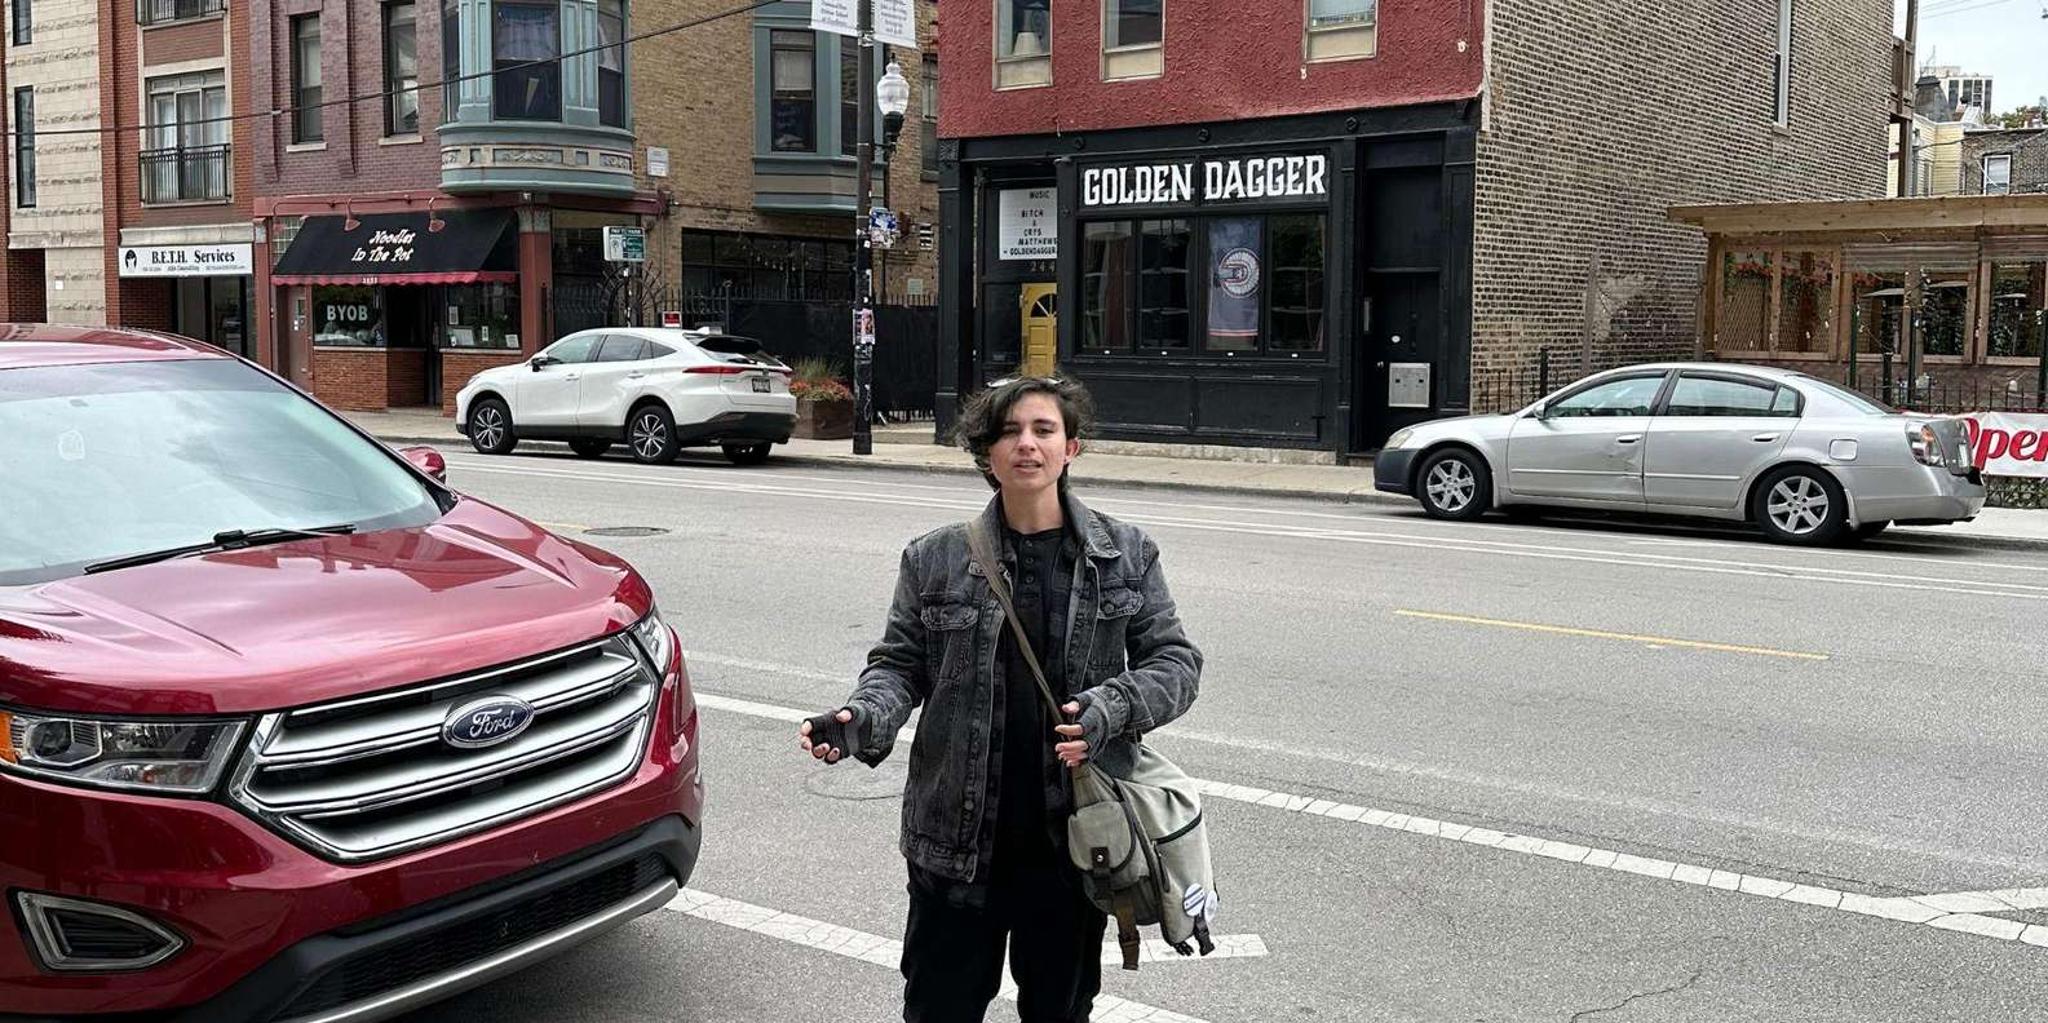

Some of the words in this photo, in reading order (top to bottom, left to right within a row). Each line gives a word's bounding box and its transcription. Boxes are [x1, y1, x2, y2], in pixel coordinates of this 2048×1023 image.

[1084, 163, 1193, 206] GOLDEN
[1204, 154, 1326, 200] DAGGER
[1029, 190, 1050, 199] MUSIC
[1021, 209, 1044, 218] BITCH
[368, 229, 416, 244] Noodles
[151, 250, 188, 264] B.E.T.H.
[194, 248, 235, 263] Services
[351, 248, 366, 261] In
[368, 246, 390, 261] The
[391, 246, 414, 261] Pot
[326, 305, 368, 321] BYOB
[1964, 417, 2048, 471] pe
[469, 708, 515, 738] Ford
